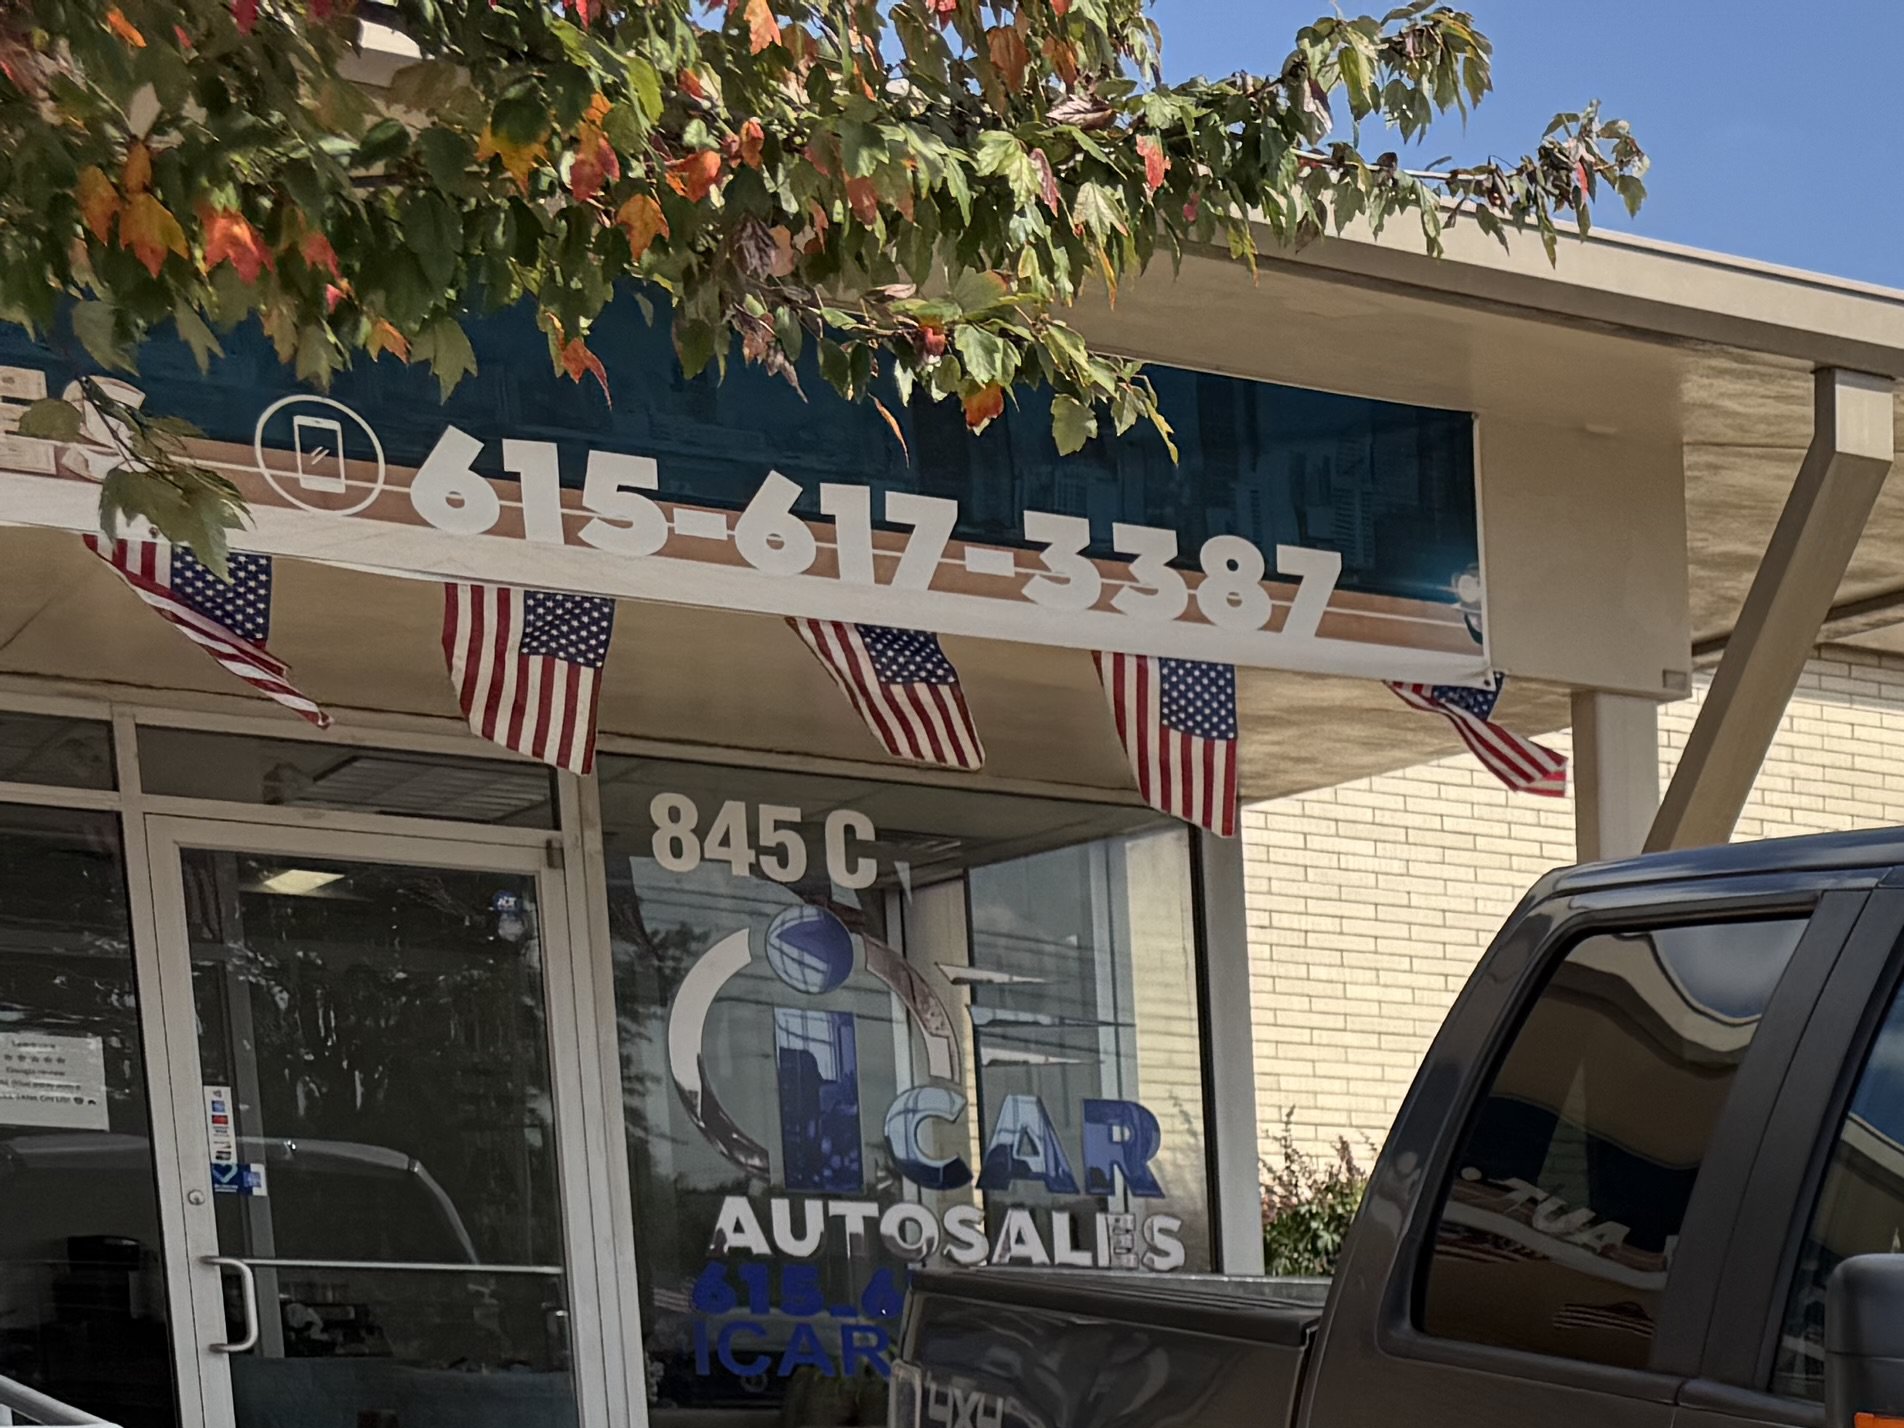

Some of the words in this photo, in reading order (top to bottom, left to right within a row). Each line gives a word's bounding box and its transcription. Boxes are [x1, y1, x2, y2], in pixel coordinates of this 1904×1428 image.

[410, 425, 1342, 638] 615-617-3387
[650, 792, 807, 882] 845
[825, 809, 878, 889] C
[692, 1318, 891, 1378] ICAR
